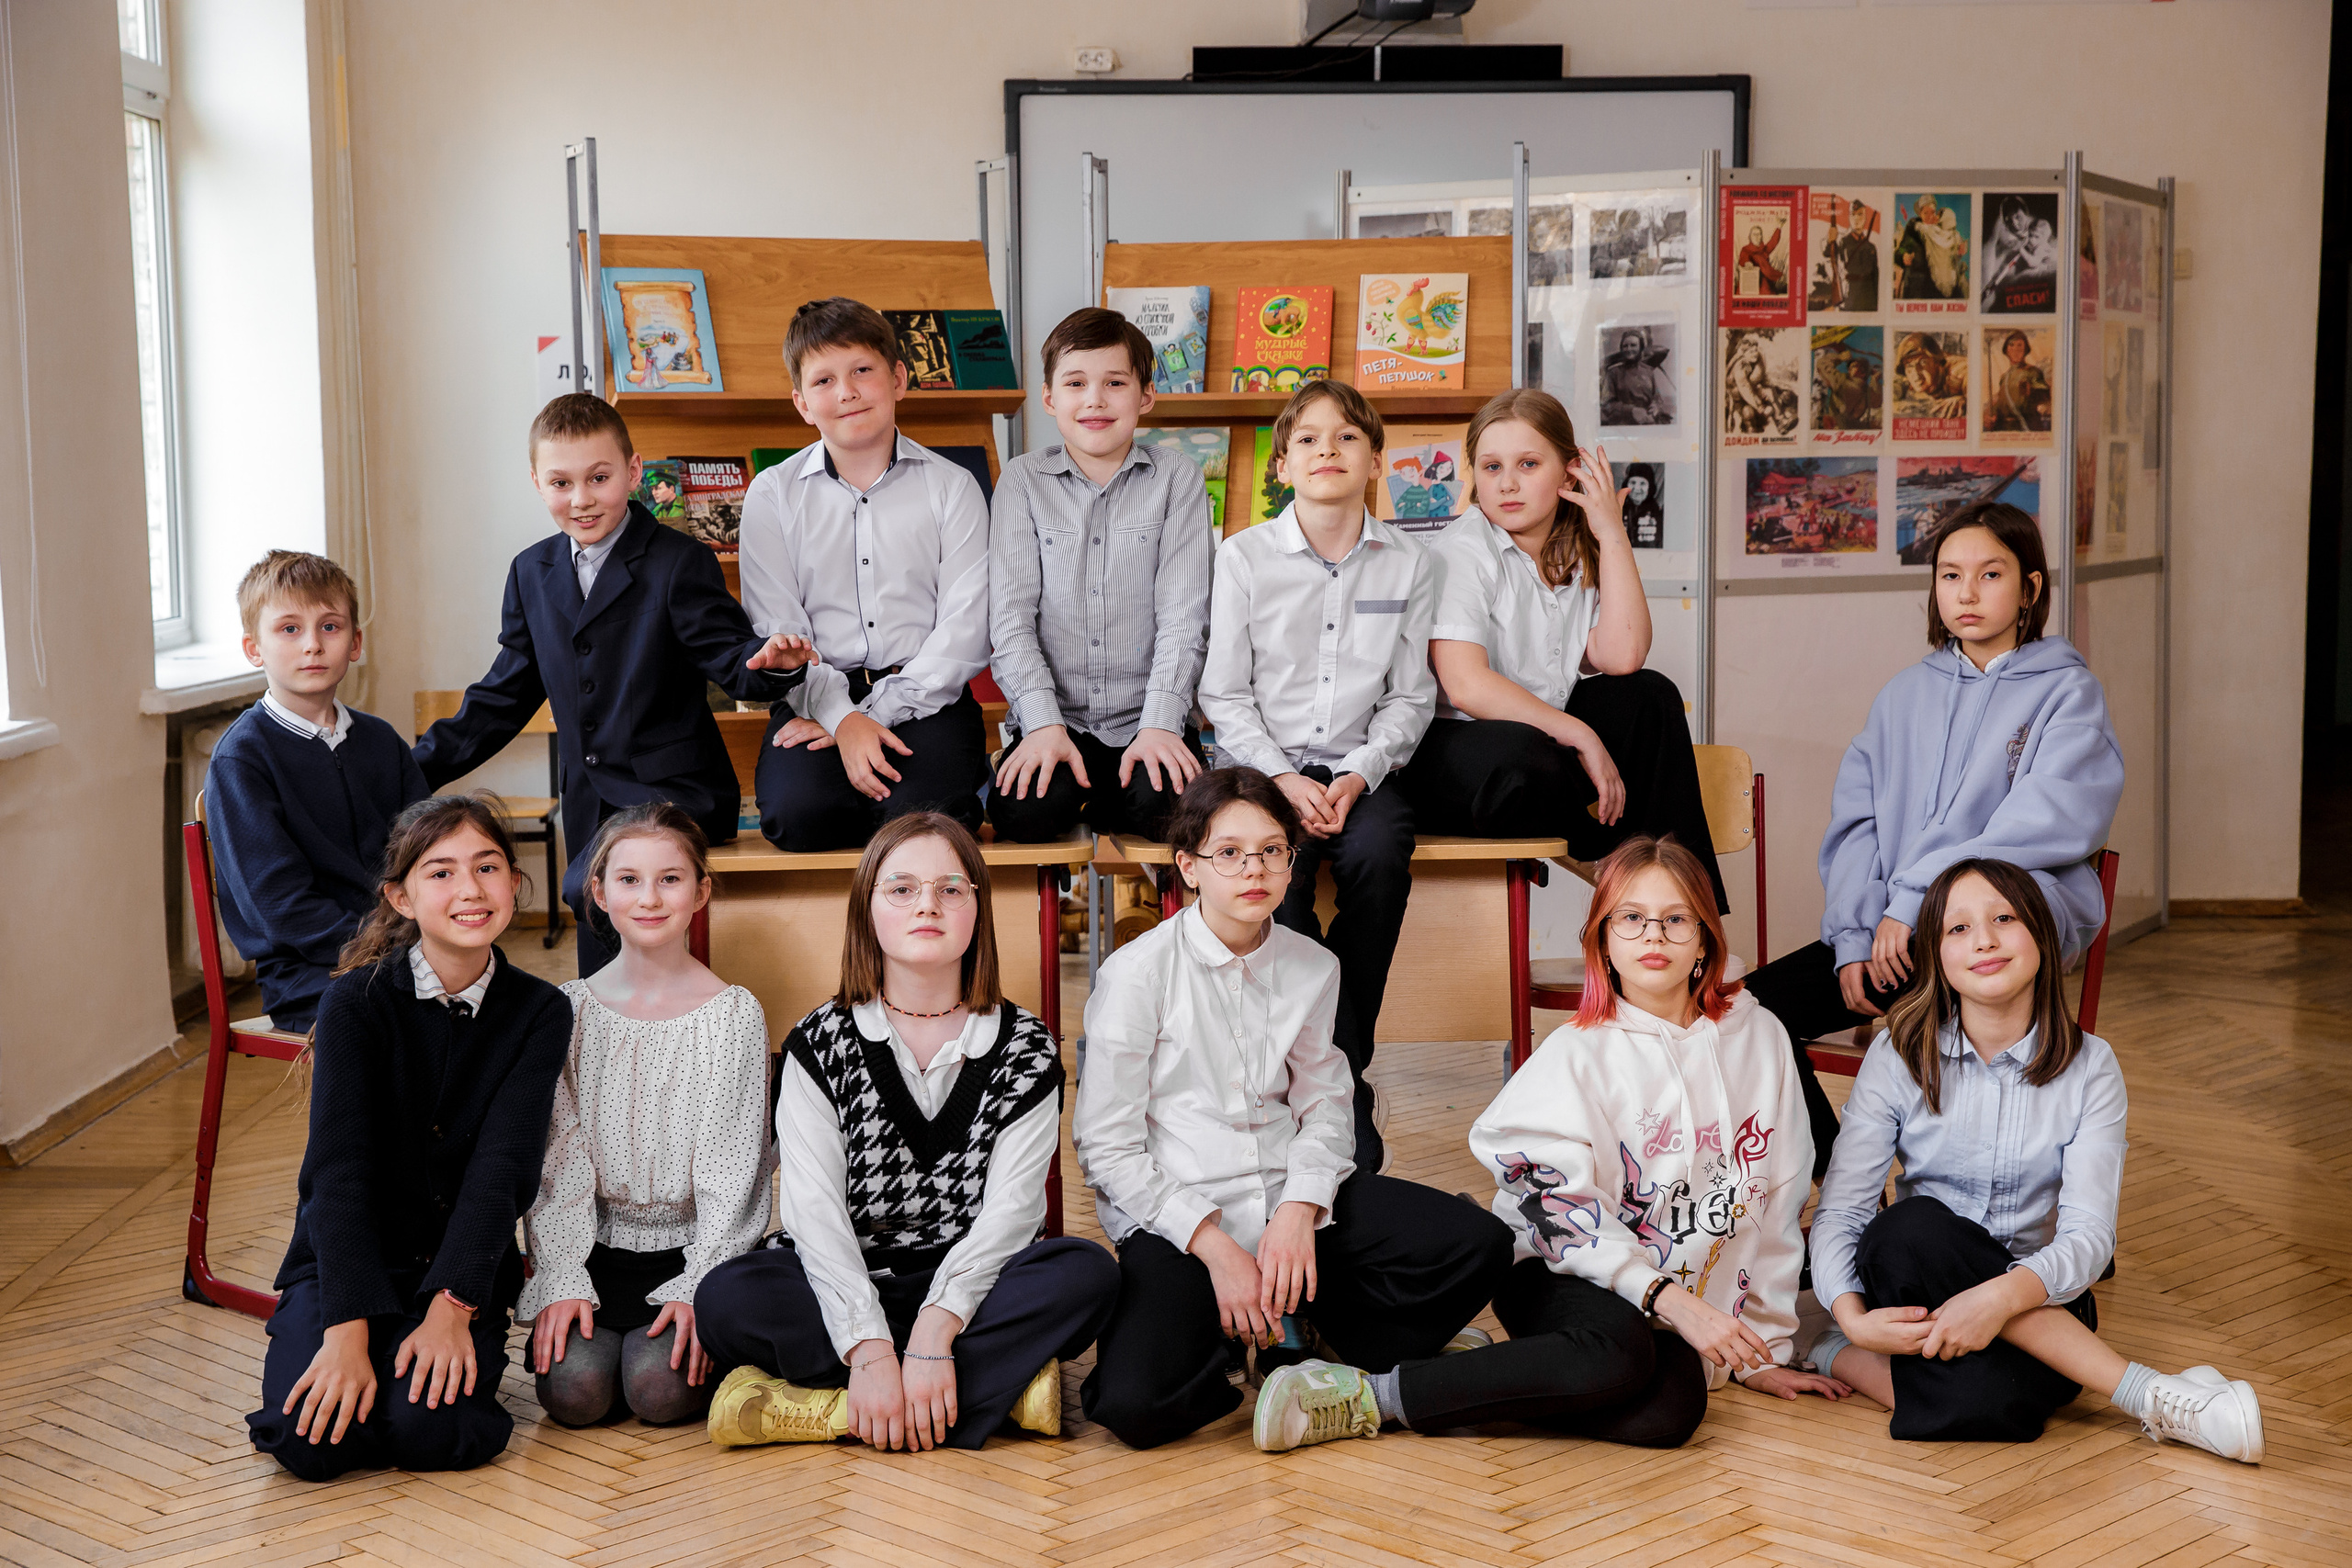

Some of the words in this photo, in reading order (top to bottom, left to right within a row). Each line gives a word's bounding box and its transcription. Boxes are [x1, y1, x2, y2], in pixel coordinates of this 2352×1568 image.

[2006, 289, 2050, 309] СПАСИ!
[1255, 338, 1308, 354] МУДРЫЕ
[1257, 350, 1304, 364] СКАЗКИ
[1362, 357, 1403, 376] ПЕТЯ-
[1378, 370, 1435, 385] ПЕТУШОК
[688, 462, 741, 475] ПАМЯТЬ
[691, 474, 743, 487] ПОБЕДЫ
